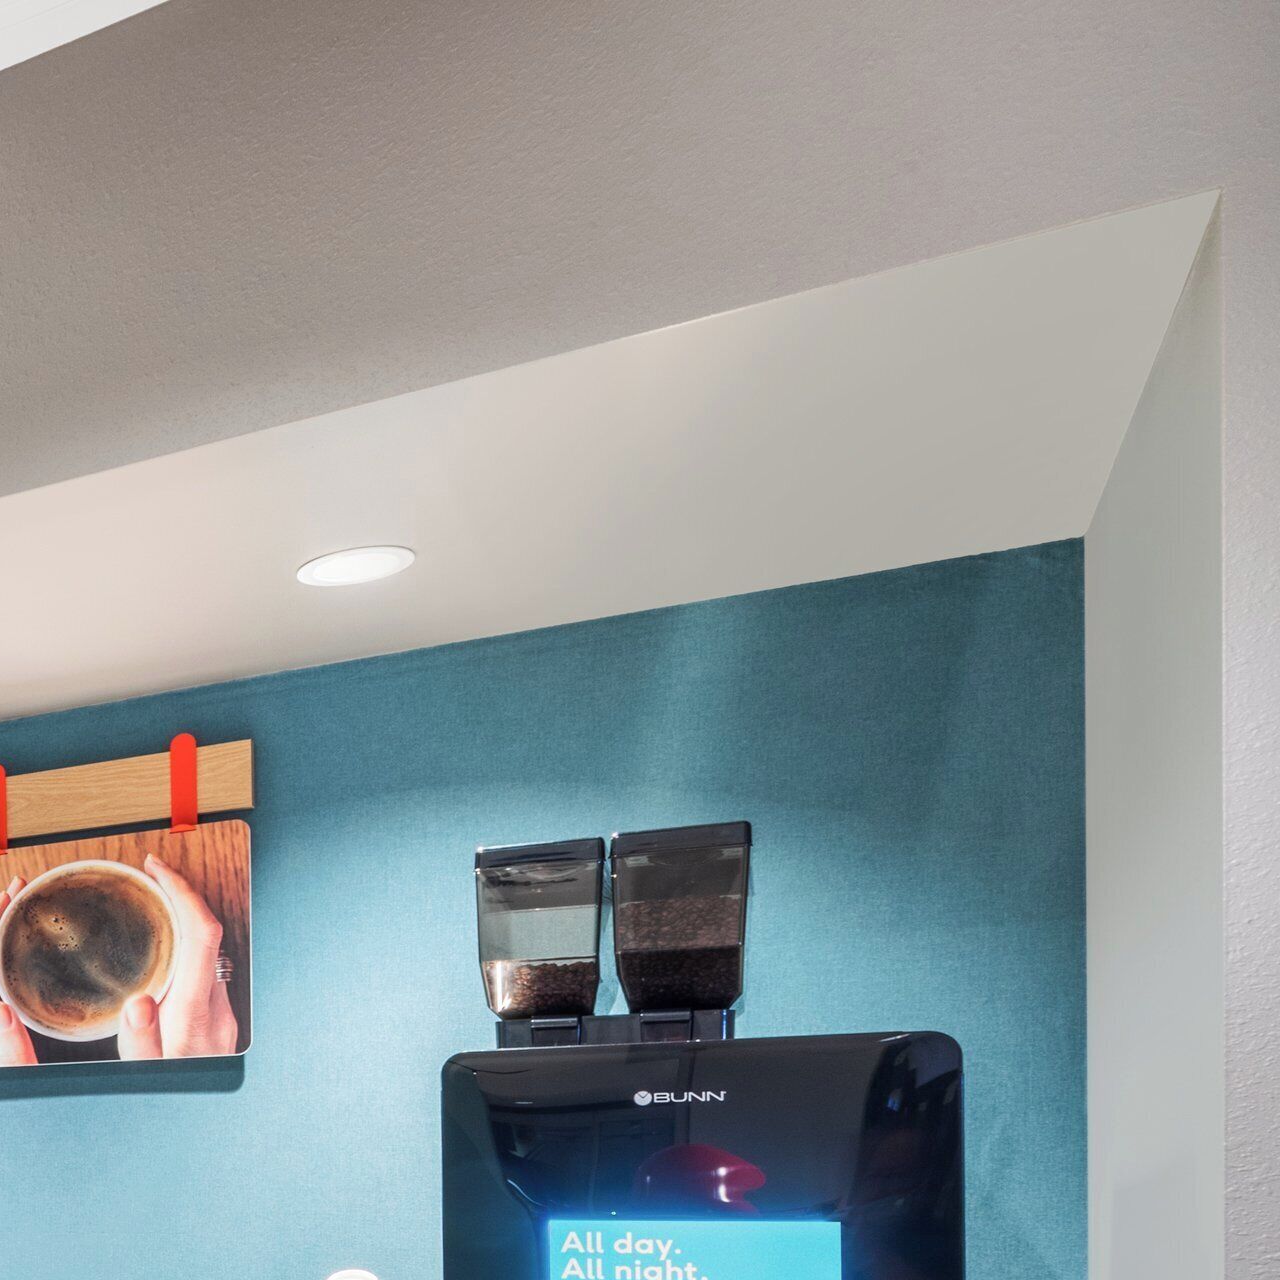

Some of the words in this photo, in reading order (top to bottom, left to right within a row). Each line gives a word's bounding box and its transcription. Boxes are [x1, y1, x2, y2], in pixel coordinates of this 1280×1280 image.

[653, 1090, 727, 1103] BUNN
[560, 1231, 605, 1254] All
[613, 1231, 682, 1261] day.
[560, 1257, 605, 1280] All
